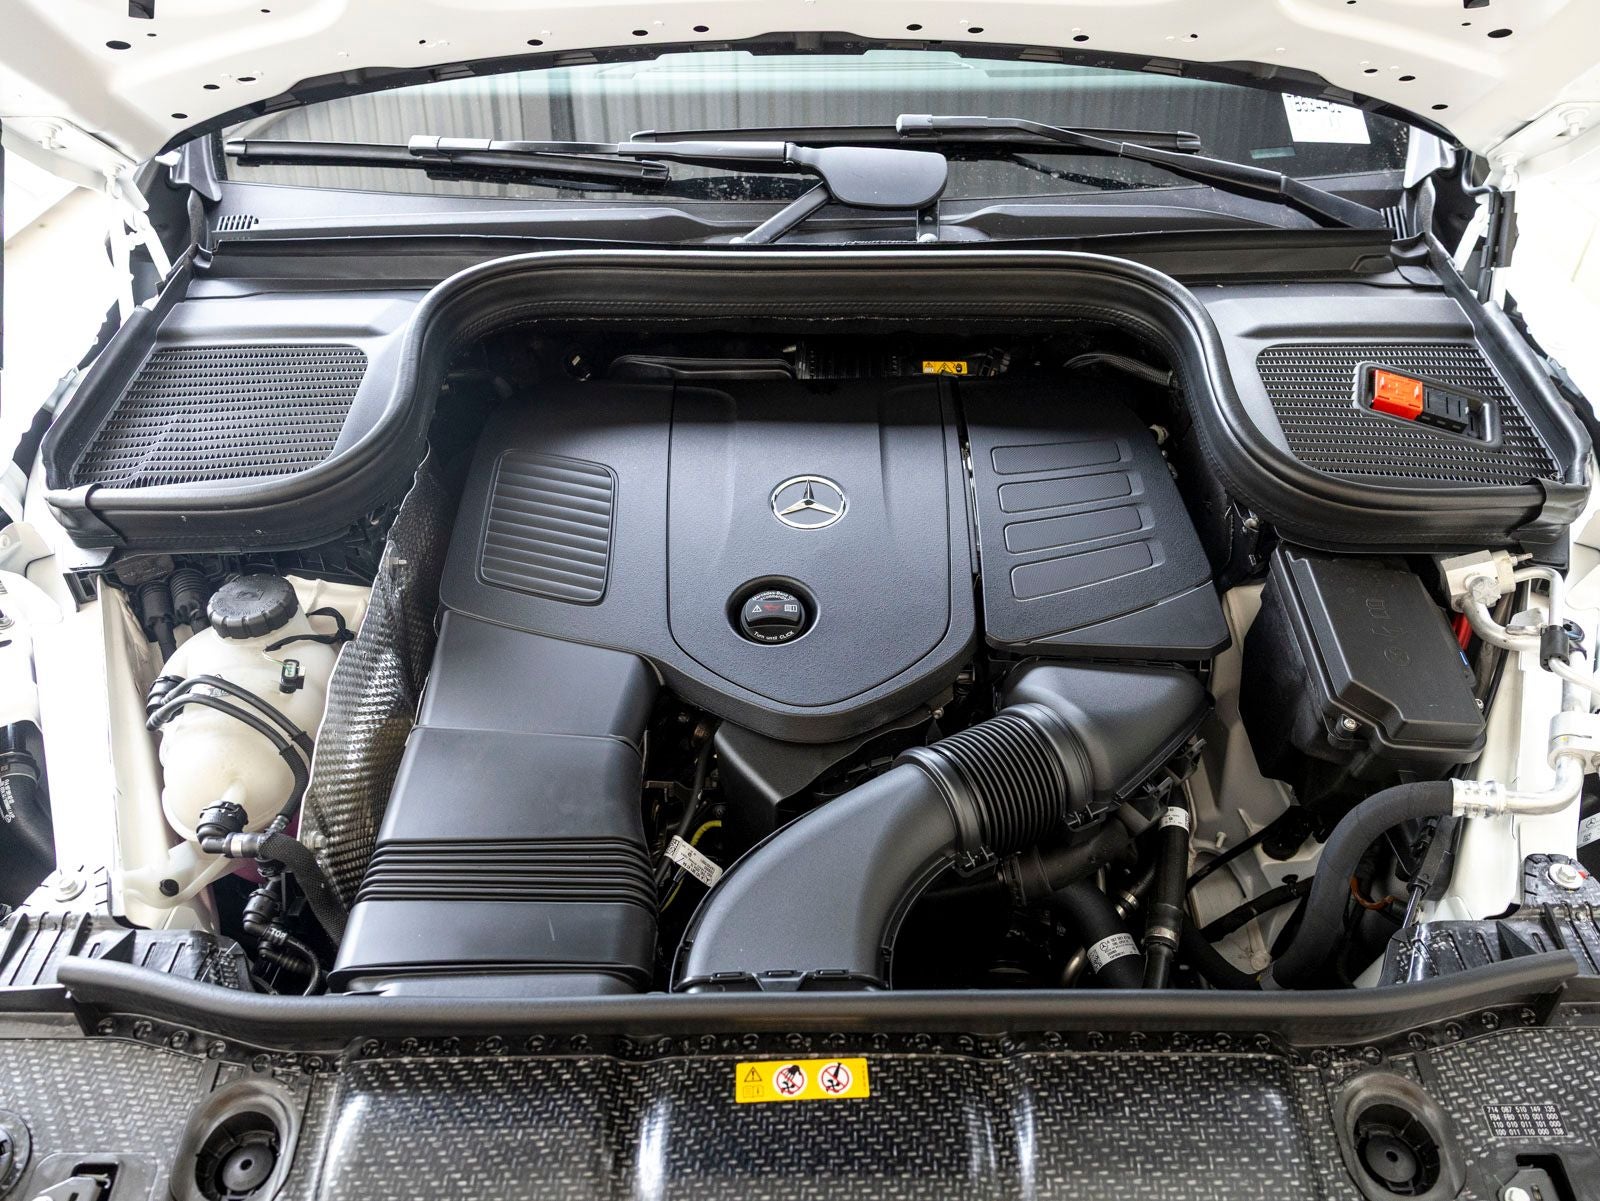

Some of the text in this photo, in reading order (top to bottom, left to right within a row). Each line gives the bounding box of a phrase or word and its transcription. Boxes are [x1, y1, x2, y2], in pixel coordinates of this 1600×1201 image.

[754, 630, 764, 639] Turn
[780, 630, 794, 640] CLICK
[272, 928, 288, 938] TOP
